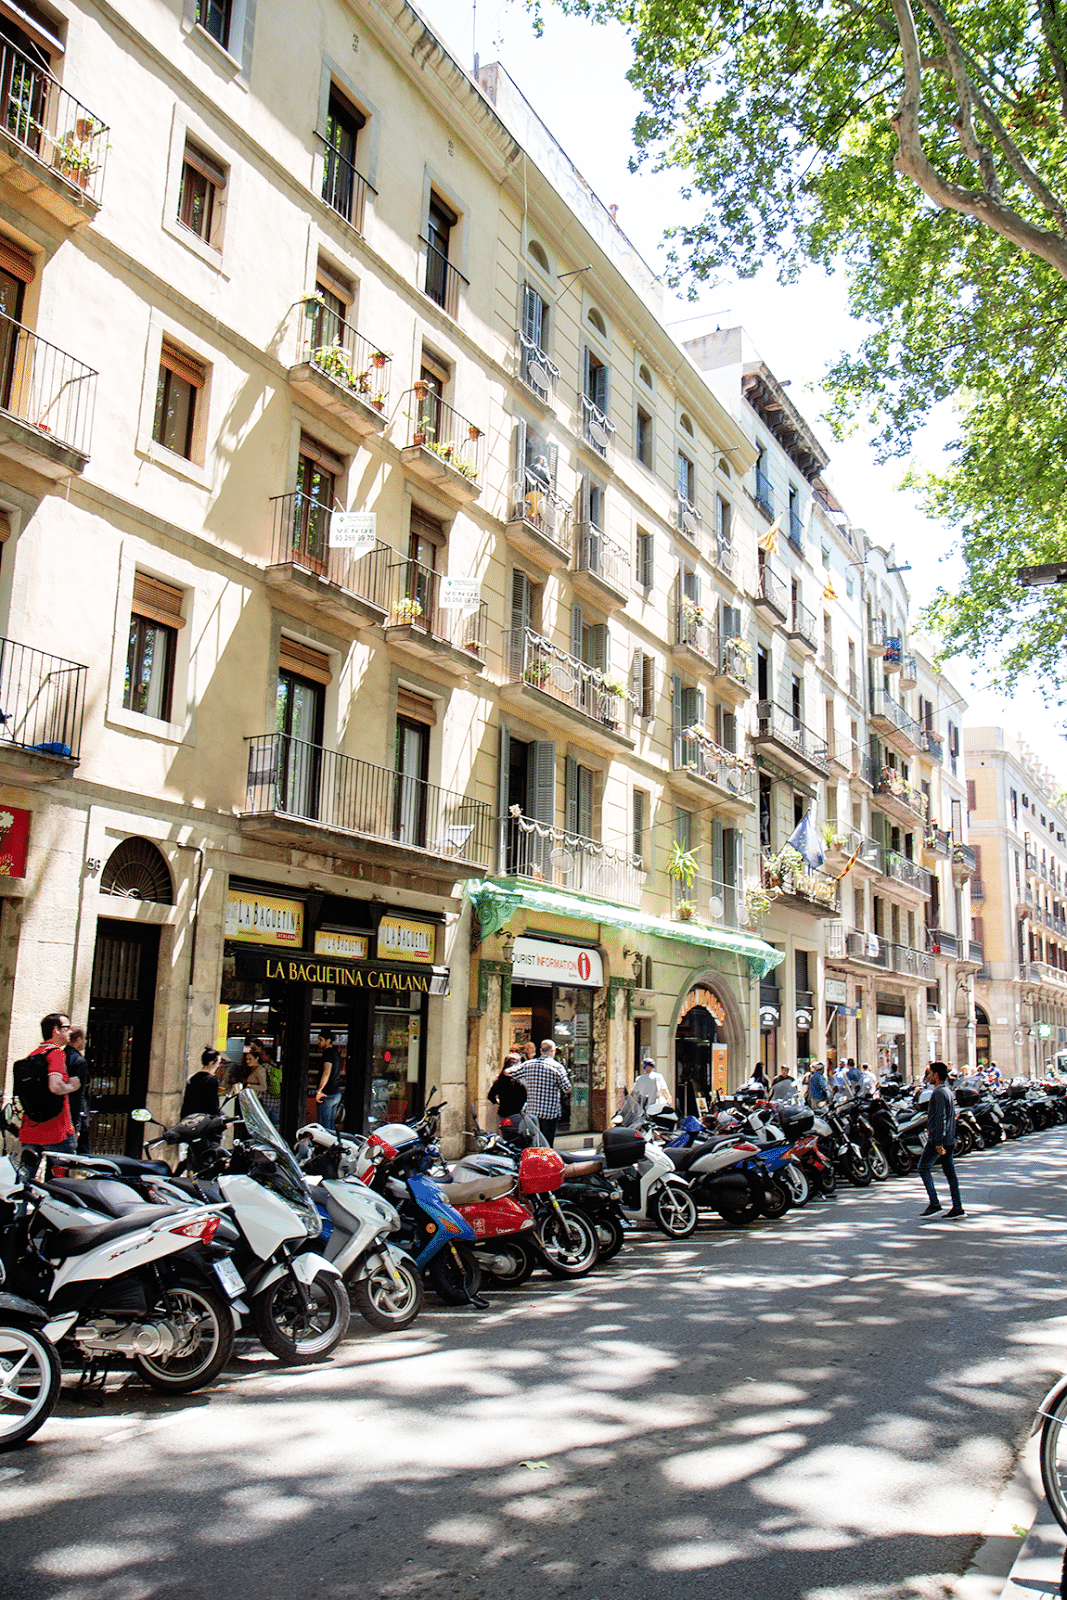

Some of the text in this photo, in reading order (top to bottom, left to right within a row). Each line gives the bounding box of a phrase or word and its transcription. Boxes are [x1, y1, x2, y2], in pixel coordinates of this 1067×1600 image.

[87, 857, 101, 871] 56
[511, 952, 536, 966] OURIST
[266, 959, 428, 992] LA BAGUETINA CATALANA
